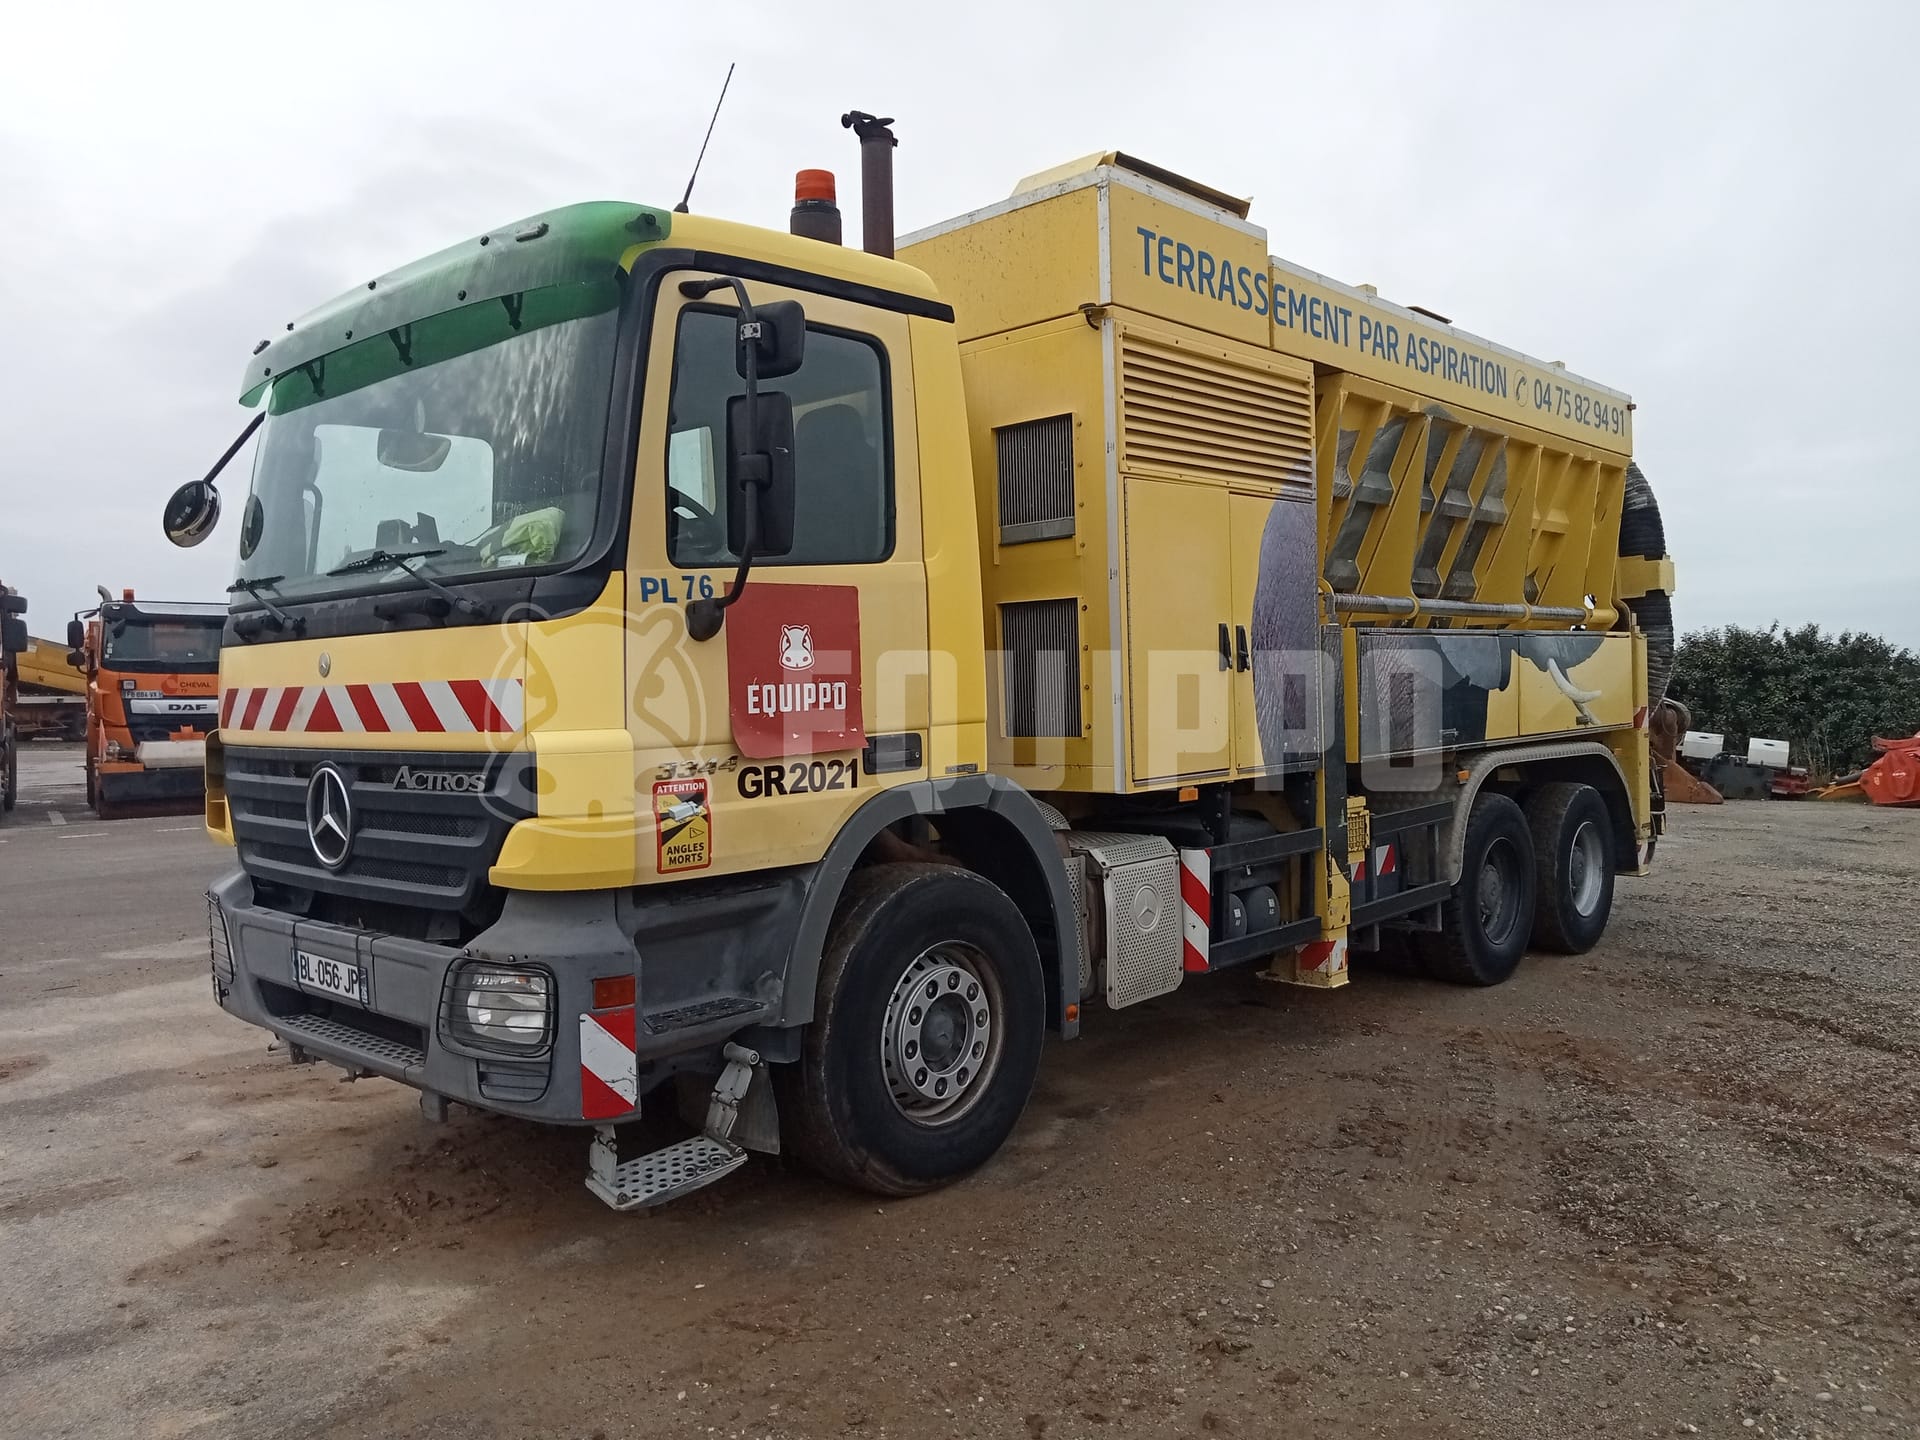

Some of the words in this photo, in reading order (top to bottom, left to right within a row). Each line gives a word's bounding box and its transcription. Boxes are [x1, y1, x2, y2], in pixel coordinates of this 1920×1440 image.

[1137, 226, 1352, 347] TERRASSEMENT
[1360, 315, 1399, 365] PAR
[1405, 334, 1507, 398] ASPIRATION
[1534, 378, 1552, 413] 04
[1555, 385, 1571, 419] 75
[1575, 393, 1591, 426] 82
[1594, 400, 1609, 432] 94
[1612, 407, 1624, 437] 91
[640, 577, 677, 603] PL
[681, 575, 714, 600] 76
[180, 681, 211, 689] CHEVAL
[655, 755, 739, 780] 3344
[657, 782, 705, 794] ATTENTION
[737, 758, 858, 799] GR2021
[666, 842, 705, 856] ANGLES
[668, 852, 703, 865] MORTS
